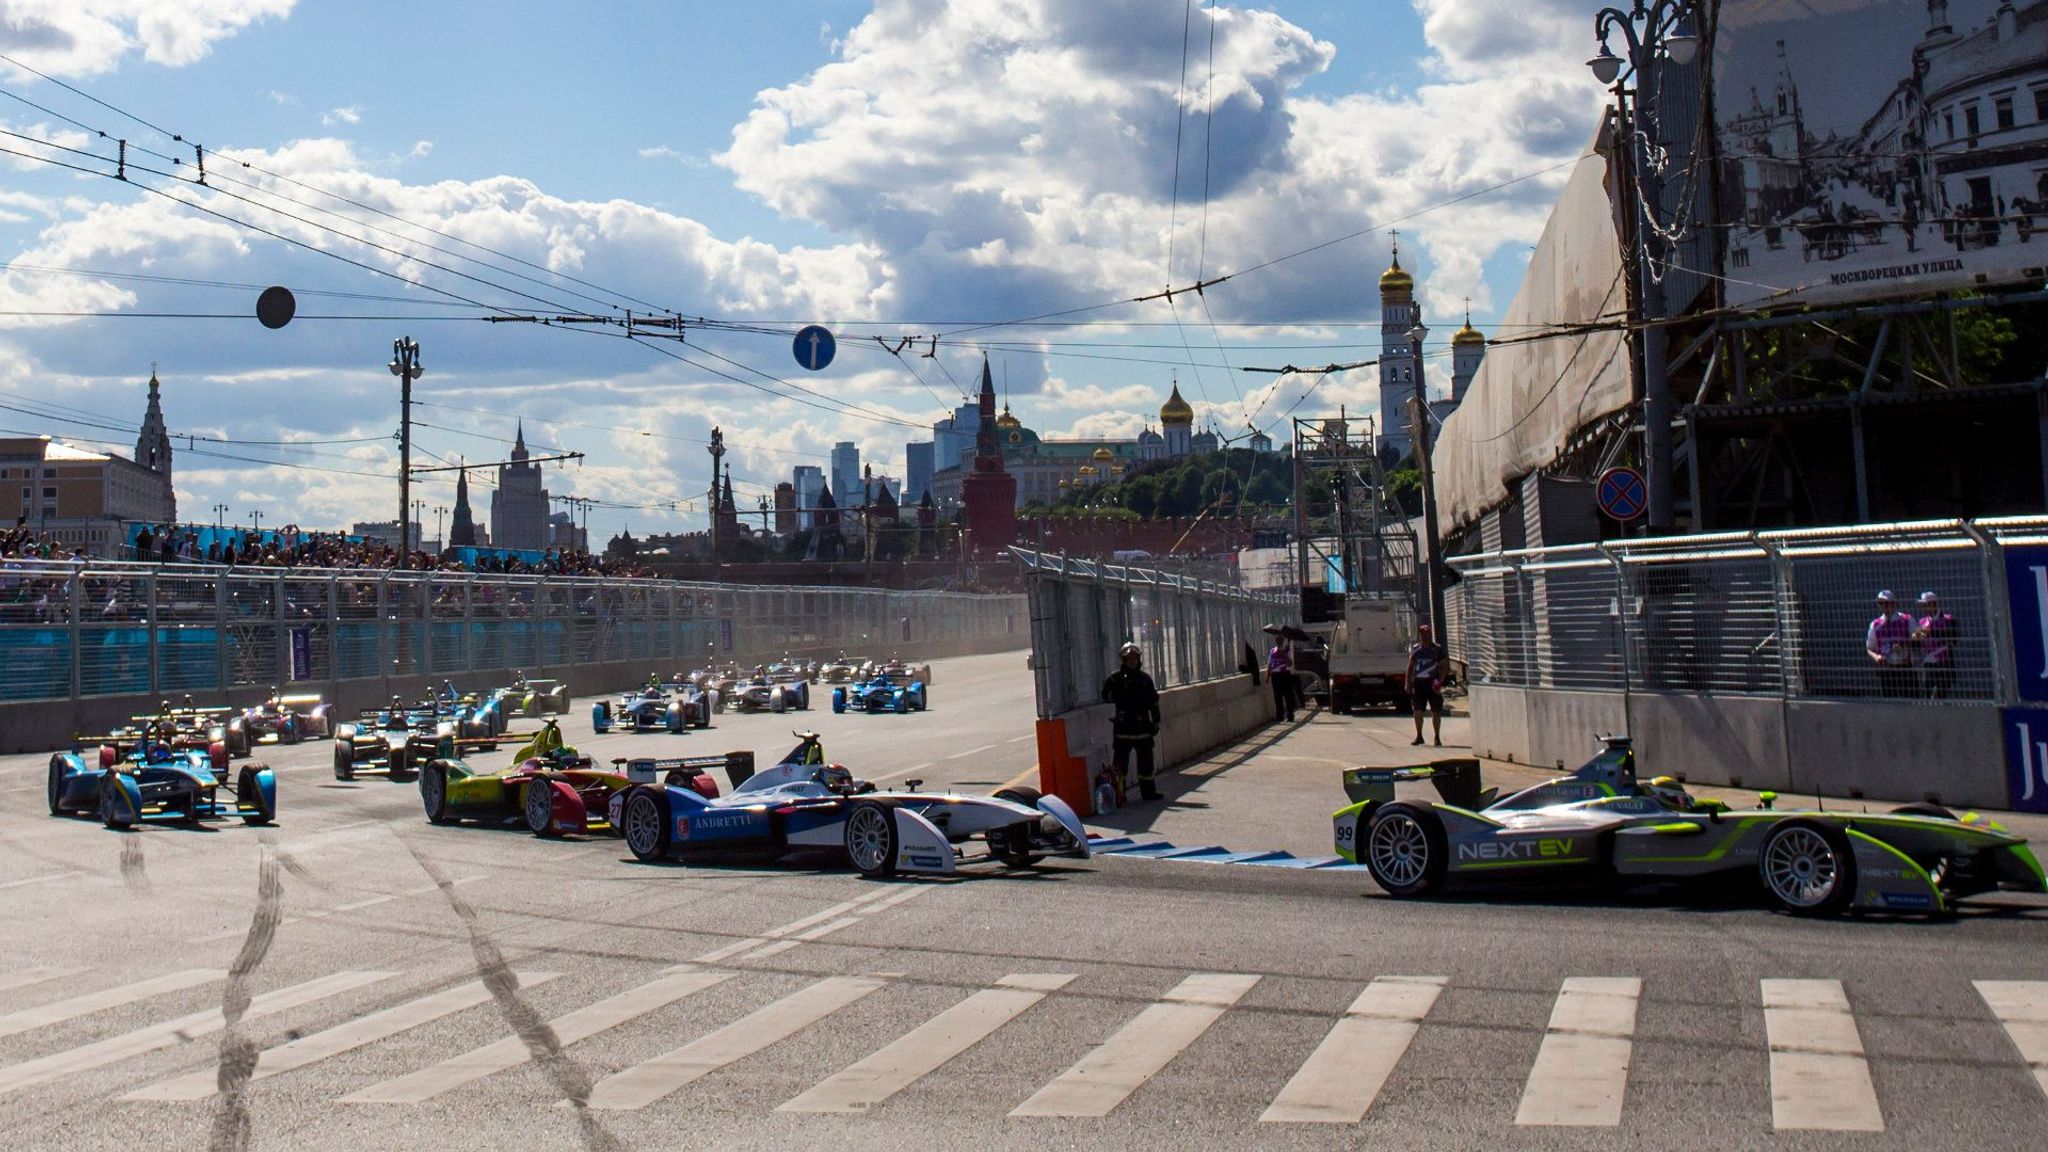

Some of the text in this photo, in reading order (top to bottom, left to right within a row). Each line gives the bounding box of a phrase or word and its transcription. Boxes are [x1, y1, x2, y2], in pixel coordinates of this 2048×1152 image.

[1830, 259, 1964, 285] МОСКВОРЕЦКАЯ УЛИЦА
[611, 803, 621, 818] 27
[695, 815, 752, 829] ANDRETTI
[1337, 826, 1353, 841] 99
[1459, 837, 1574, 860] NEXTEV
